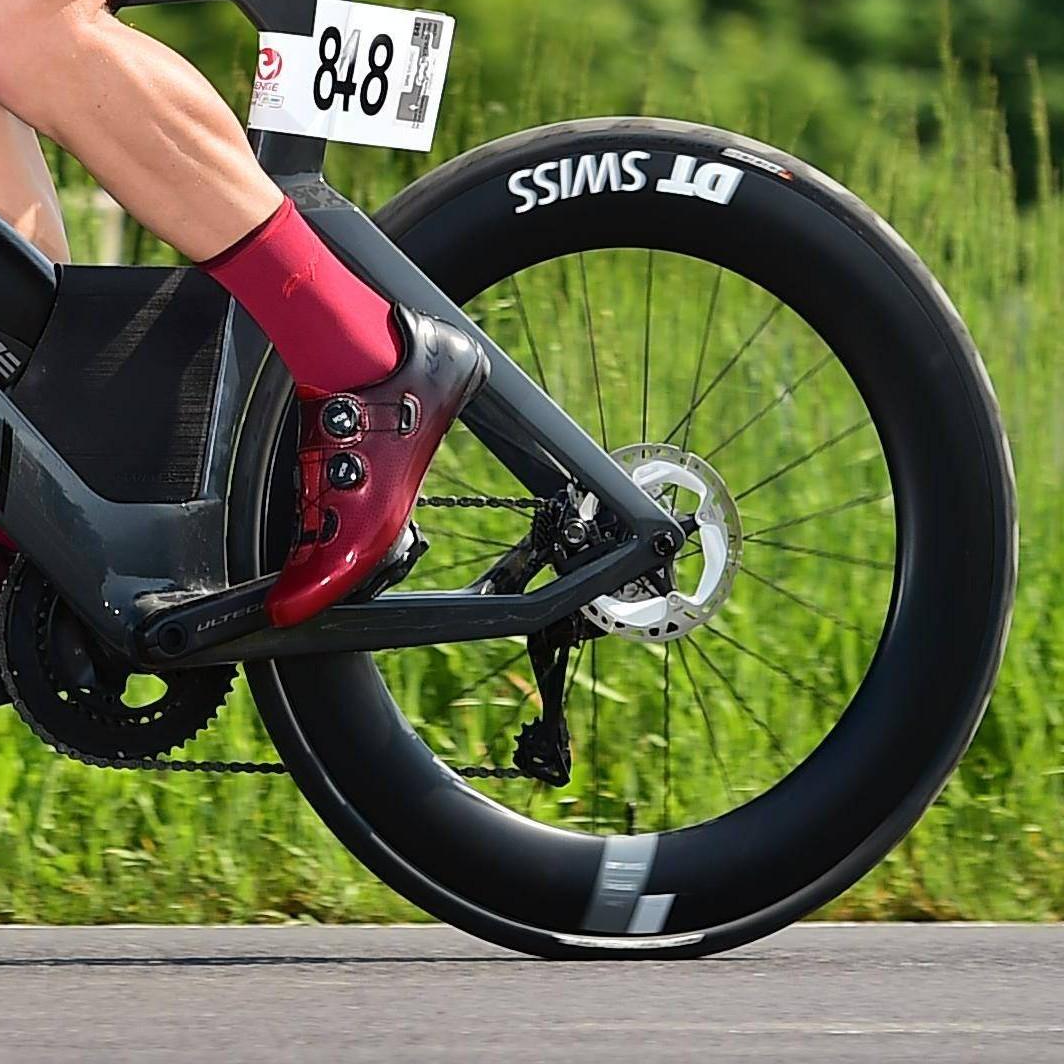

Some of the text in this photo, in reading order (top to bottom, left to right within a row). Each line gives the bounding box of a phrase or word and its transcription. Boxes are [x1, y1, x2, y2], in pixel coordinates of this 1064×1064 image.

[313, 26, 394, 116] 848
[507, 150, 652, 214] SWISS
[655, 154, 745, 205] DT
